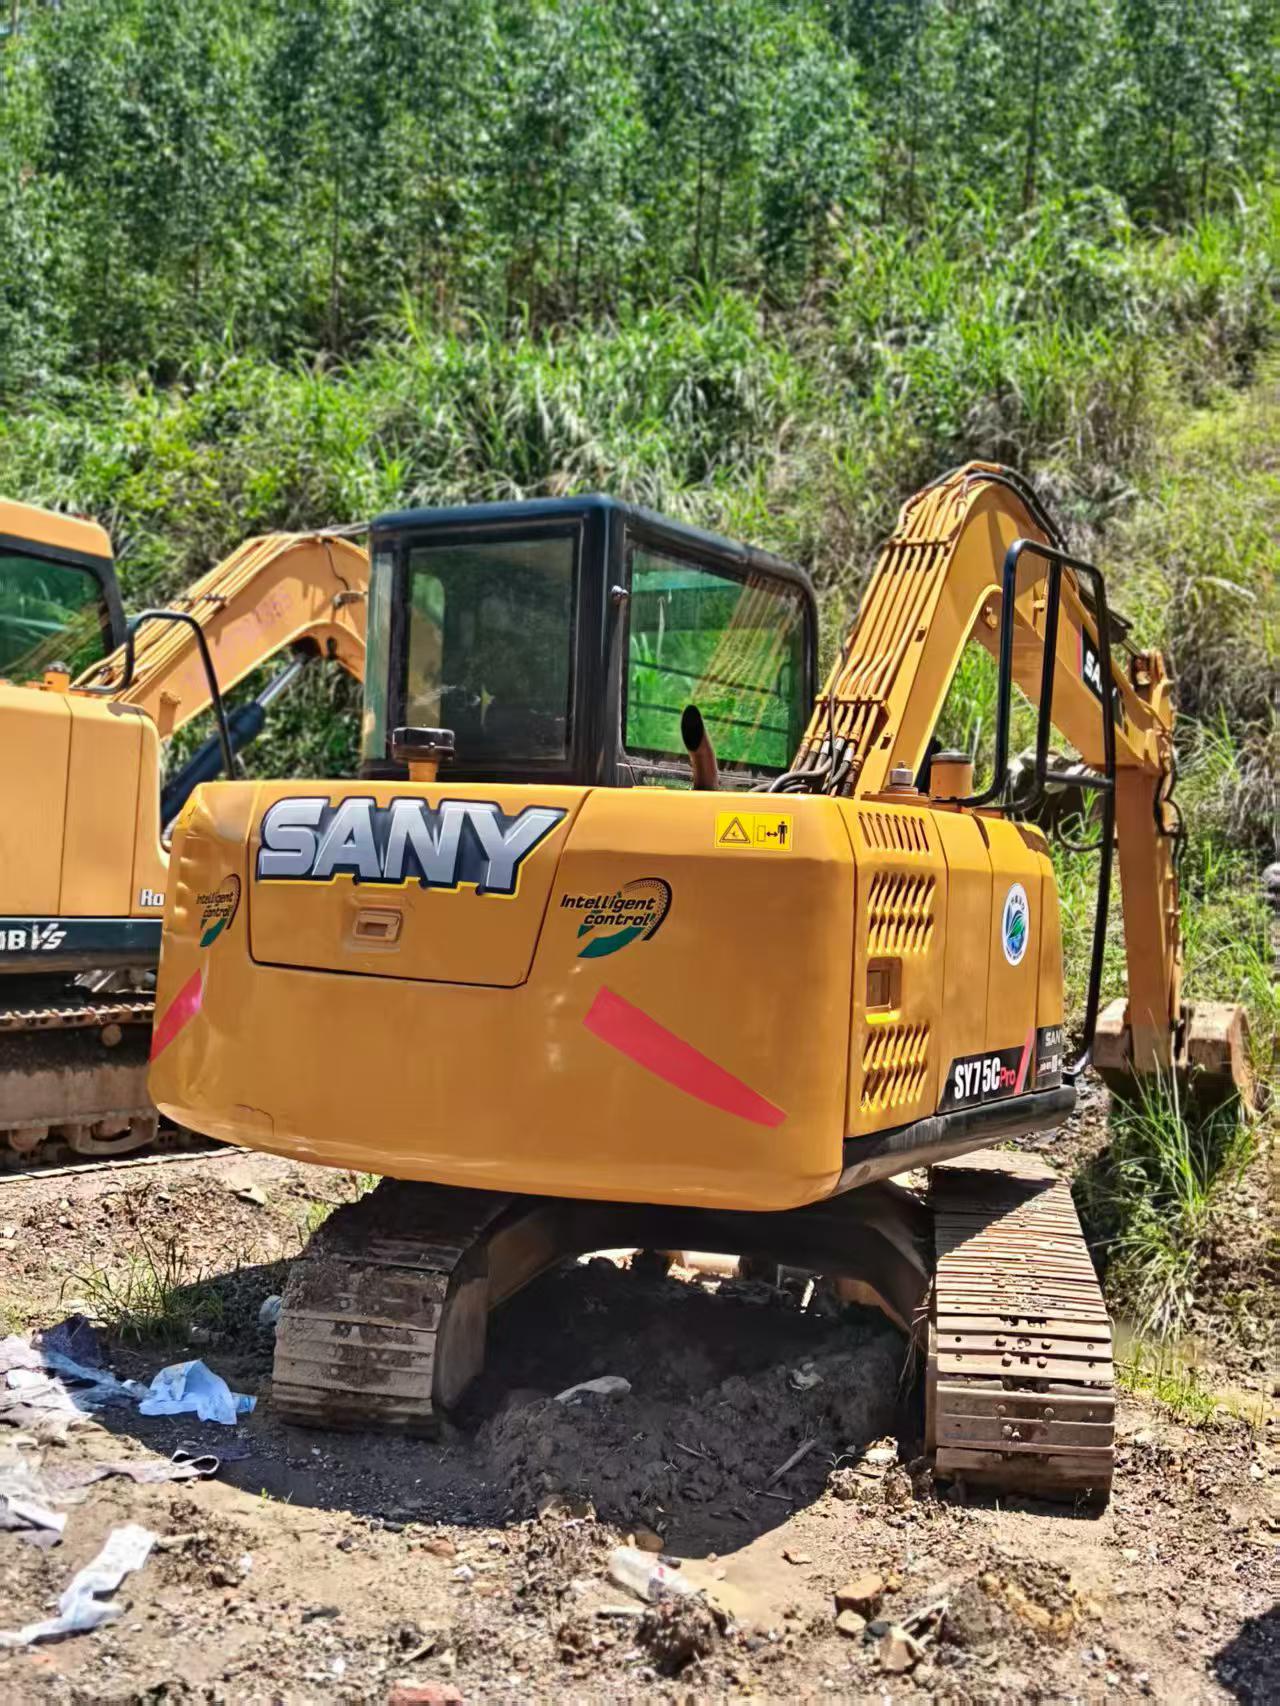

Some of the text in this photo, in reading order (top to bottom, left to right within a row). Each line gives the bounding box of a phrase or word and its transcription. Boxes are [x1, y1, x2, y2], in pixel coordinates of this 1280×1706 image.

[257, 797, 568, 894] SANY
[560, 890, 656, 912] Intelligent
[583, 912, 652, 926] control
[954, 1057, 1016, 1099] SY75C Pro
